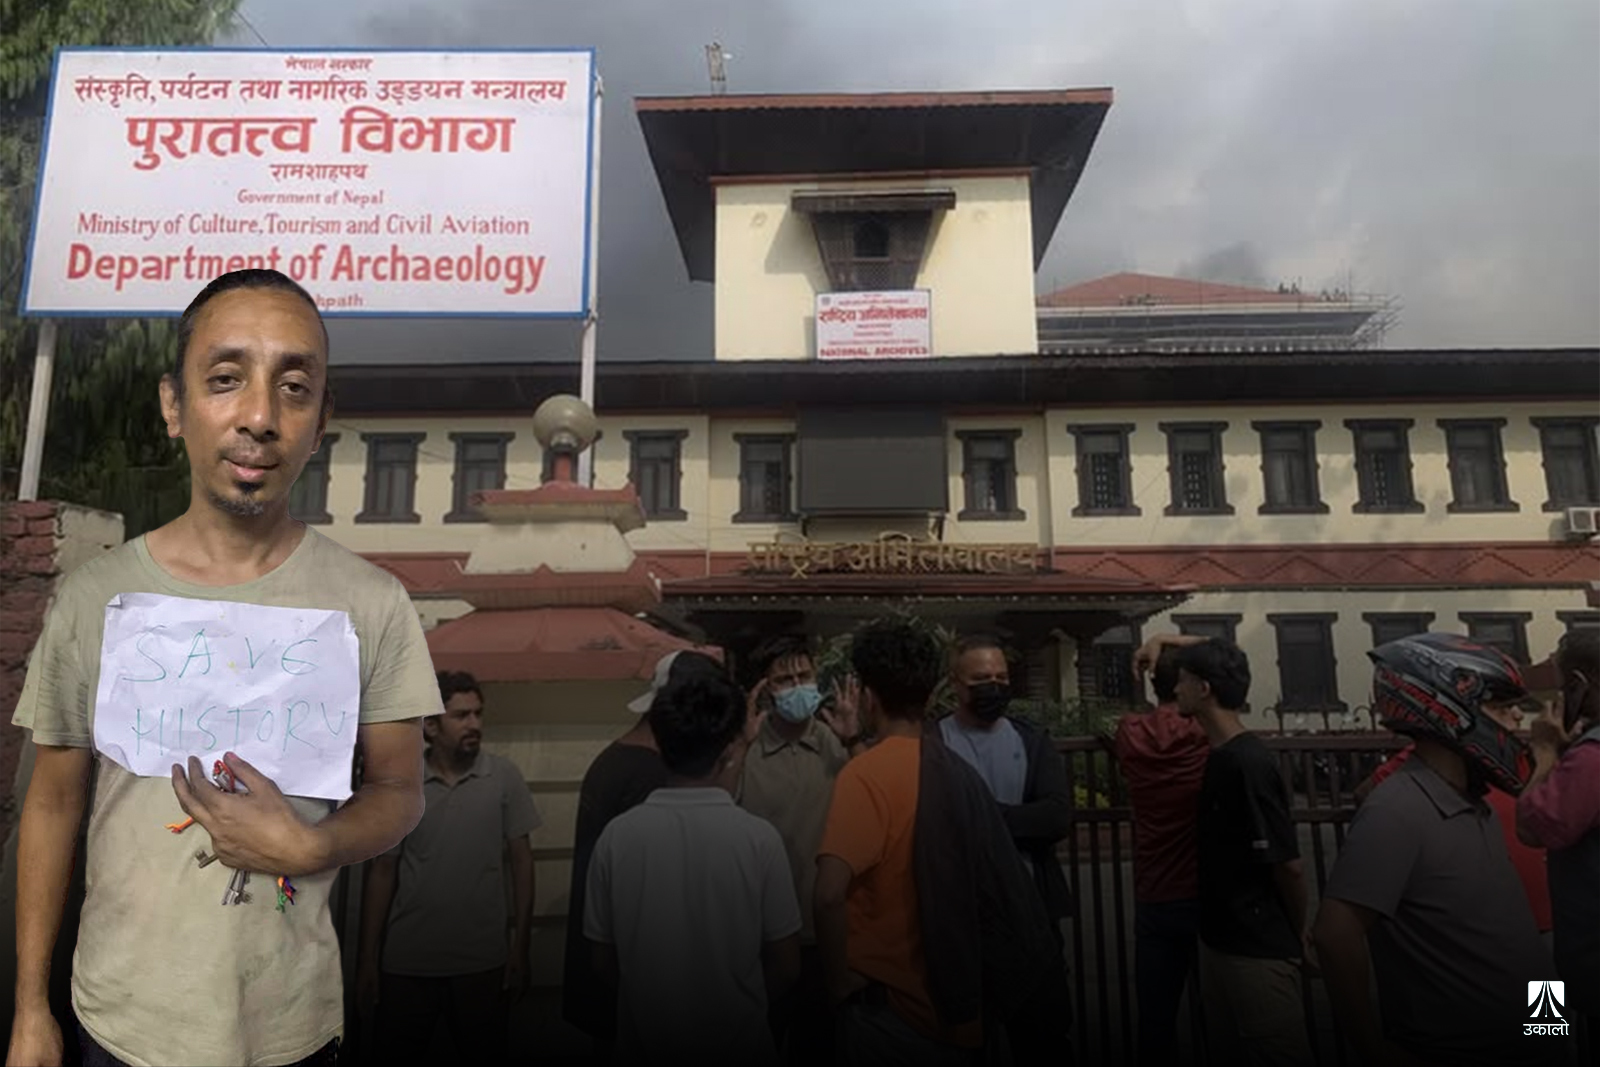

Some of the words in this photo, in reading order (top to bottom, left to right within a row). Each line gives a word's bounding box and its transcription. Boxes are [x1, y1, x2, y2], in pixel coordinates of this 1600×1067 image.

[160, 74, 230, 99] पर्यटन
[240, 80, 282, 103] तथा
[288, 75, 367, 103] नागरिक
[472, 79, 567, 103] मन्त्रालय
[340, 106, 516, 153] विभाग
[270, 163, 368, 182] रामशाहपथ
[237, 189, 321, 204] Government
[325, 190, 340, 204] of
[343, 190, 384, 208] Nepal
[77, 212, 160, 240] Ministry
[164, 214, 183, 235] of
[346, 214, 380, 235] and
[386, 213, 432, 235] Civil
[441, 214, 530, 235] Aviation
[67, 243, 281, 291] Department
[289, 244, 327, 281] of
[331, 243, 546, 294] Archaeology
[123, 625, 319, 682] SAVE
